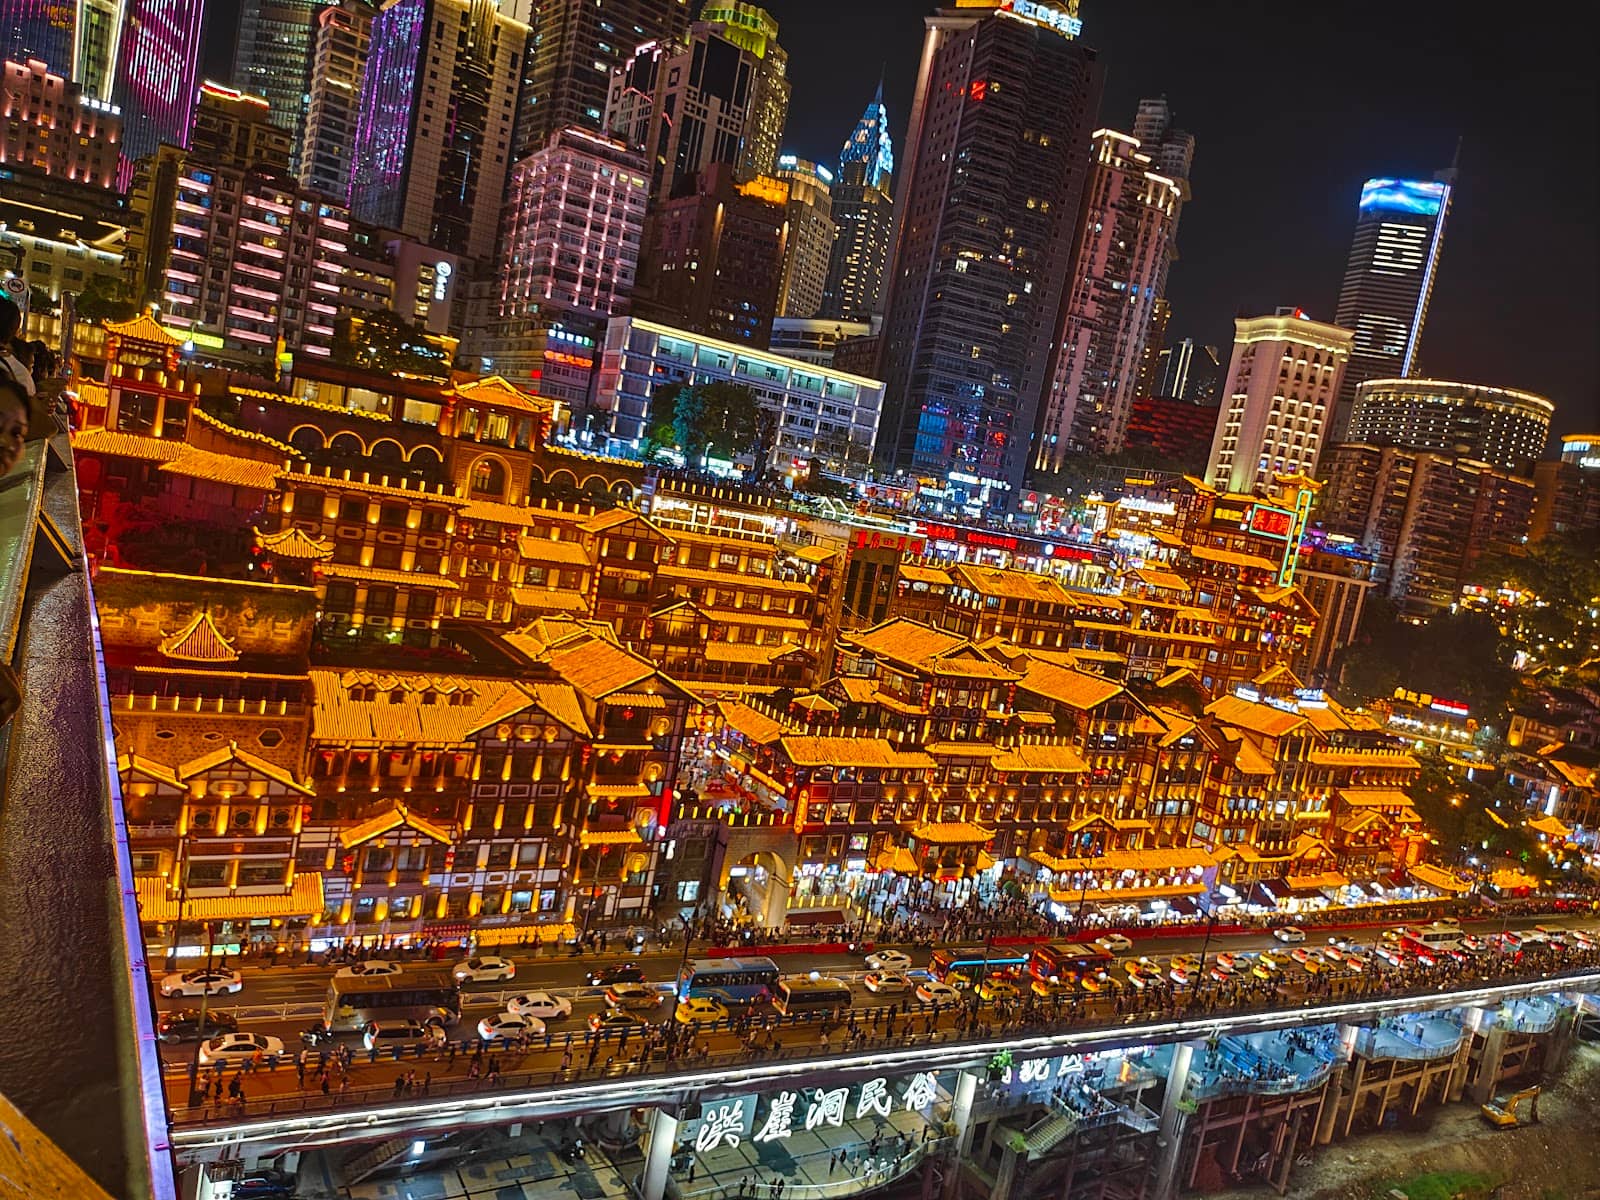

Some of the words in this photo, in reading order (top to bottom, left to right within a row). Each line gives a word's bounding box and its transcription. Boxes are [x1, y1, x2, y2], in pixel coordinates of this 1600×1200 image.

[1252, 508, 1291, 536] 洪崖洞
[696, 1071, 937, 1152] 洪崖洞民俗
